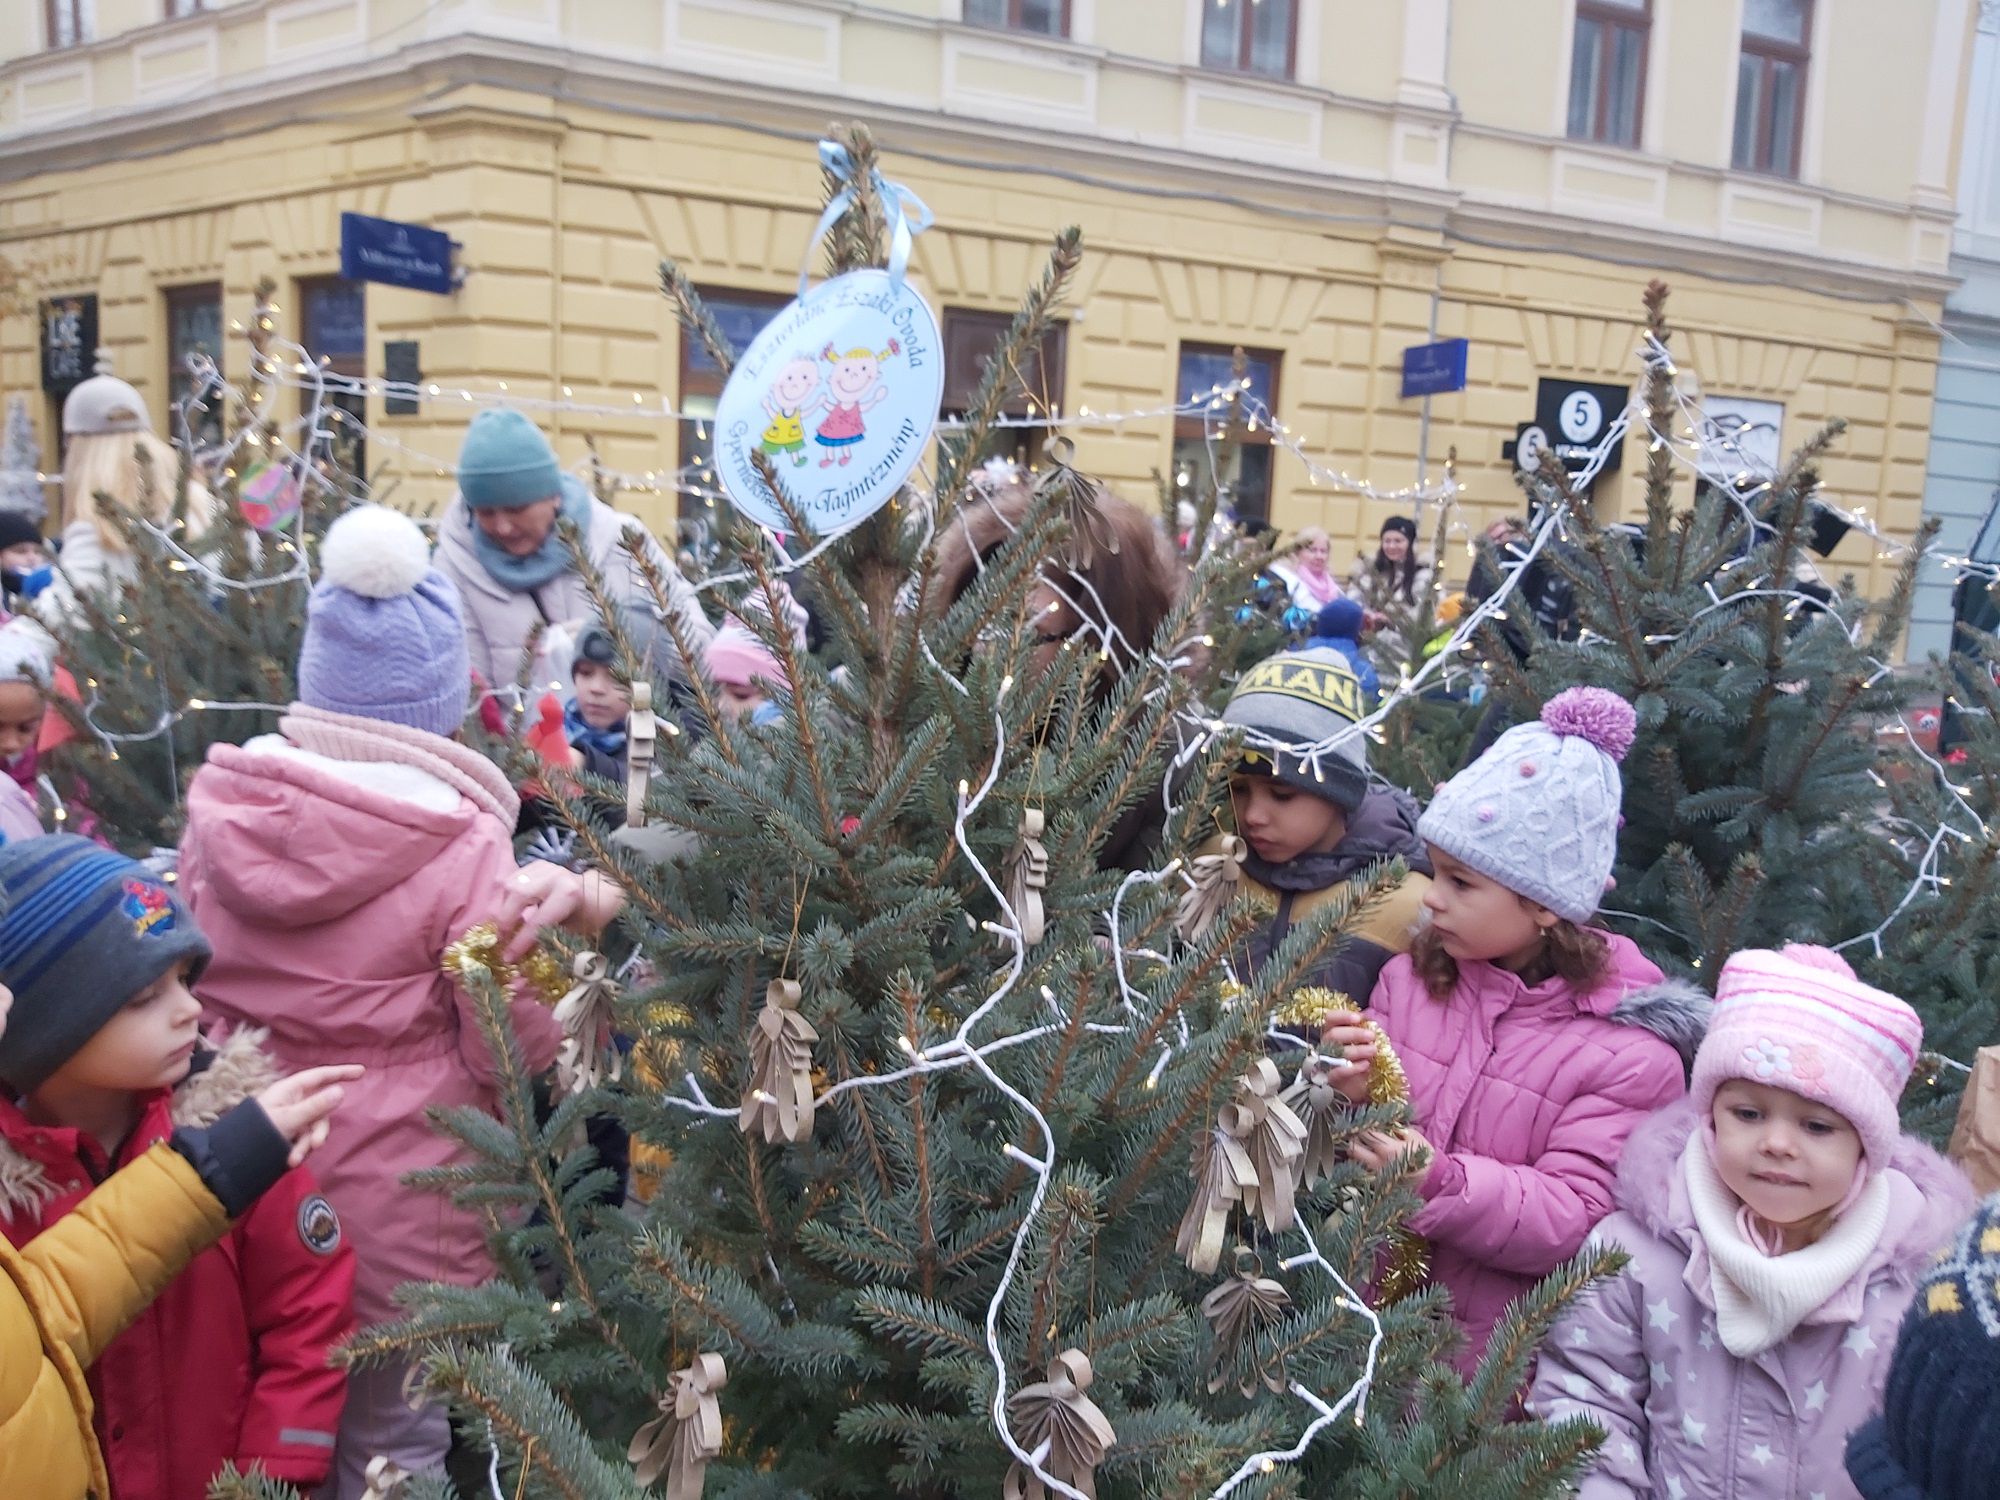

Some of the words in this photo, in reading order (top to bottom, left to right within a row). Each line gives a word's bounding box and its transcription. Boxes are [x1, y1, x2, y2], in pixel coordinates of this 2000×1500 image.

[892, 303, 927, 369] Óvoda
[1573, 400, 1589, 427] 5
[814, 417, 921, 517] Tagintézmény
[1242, 664, 1353, 711] MAN
